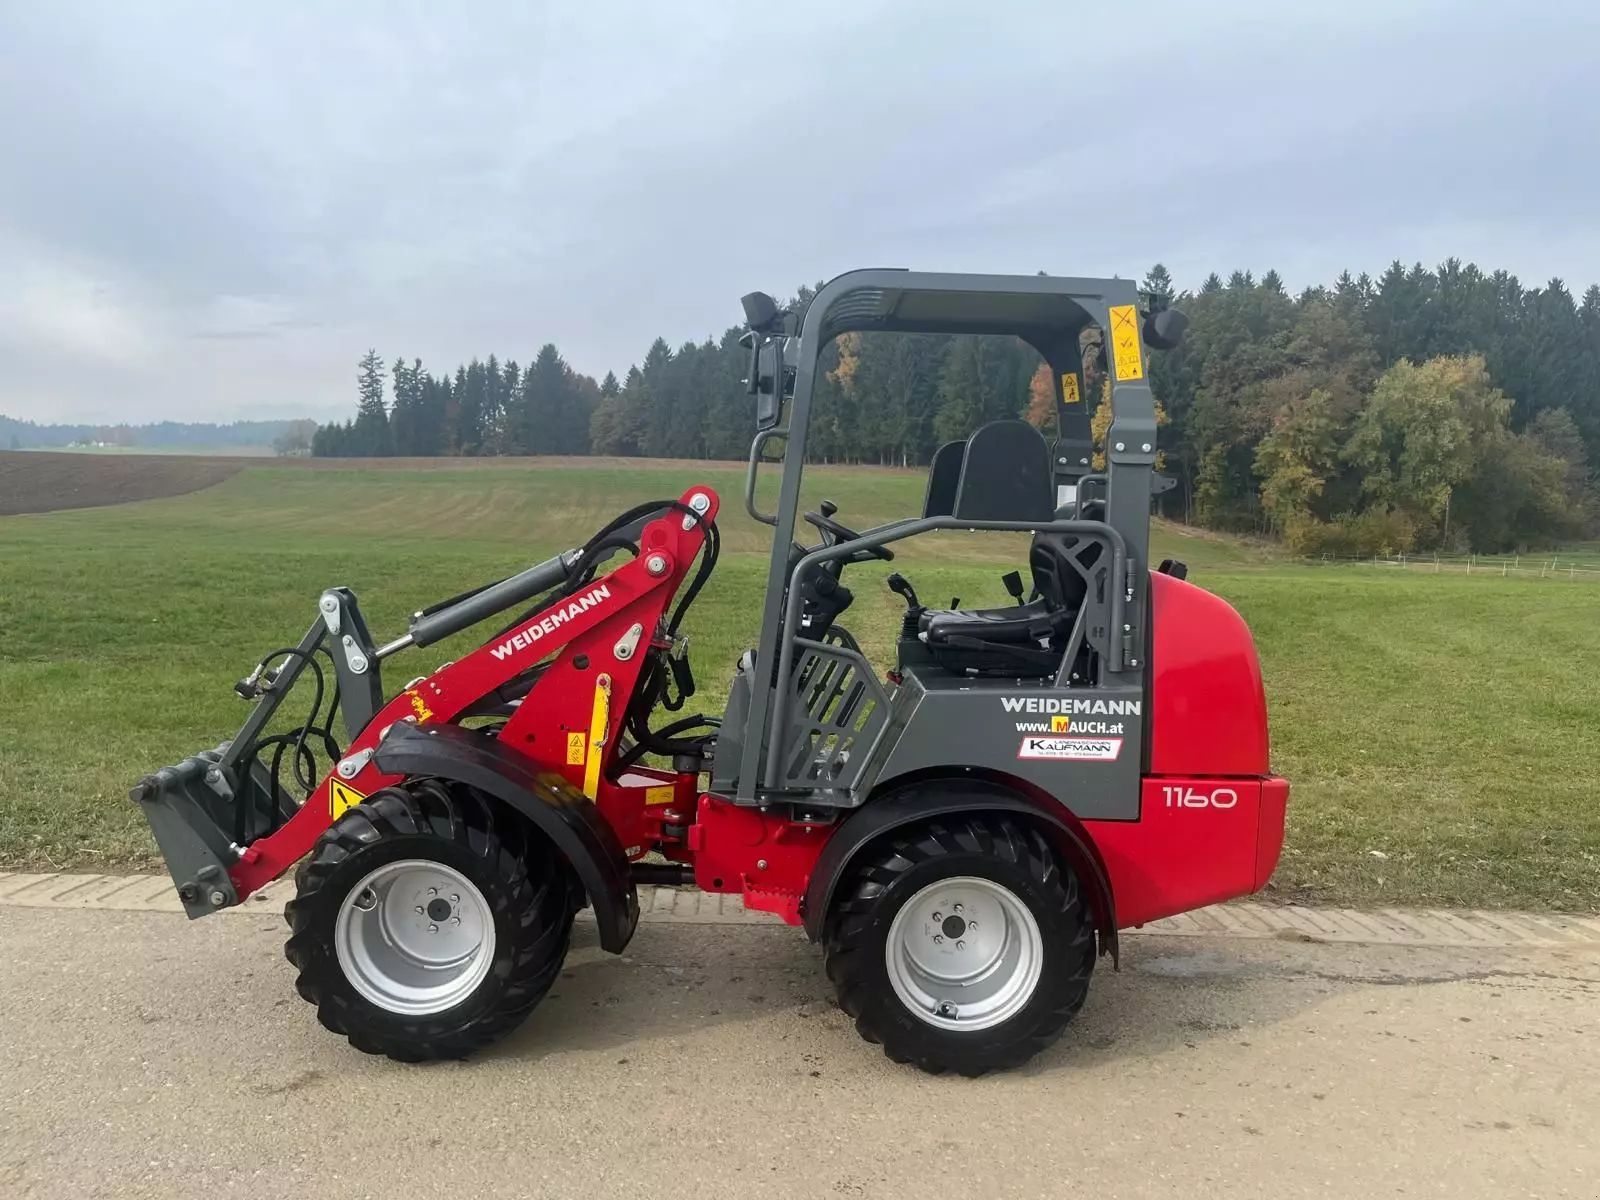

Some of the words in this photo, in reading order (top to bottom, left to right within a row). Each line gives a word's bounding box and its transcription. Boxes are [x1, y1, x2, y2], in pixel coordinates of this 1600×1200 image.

[490, 584, 611, 661] WEIDEMANN
[1001, 697, 1141, 716] WEIDEMANN
[1016, 719, 1124, 734] www.MAUCH.at
[1163, 786, 1238, 809] 1160
